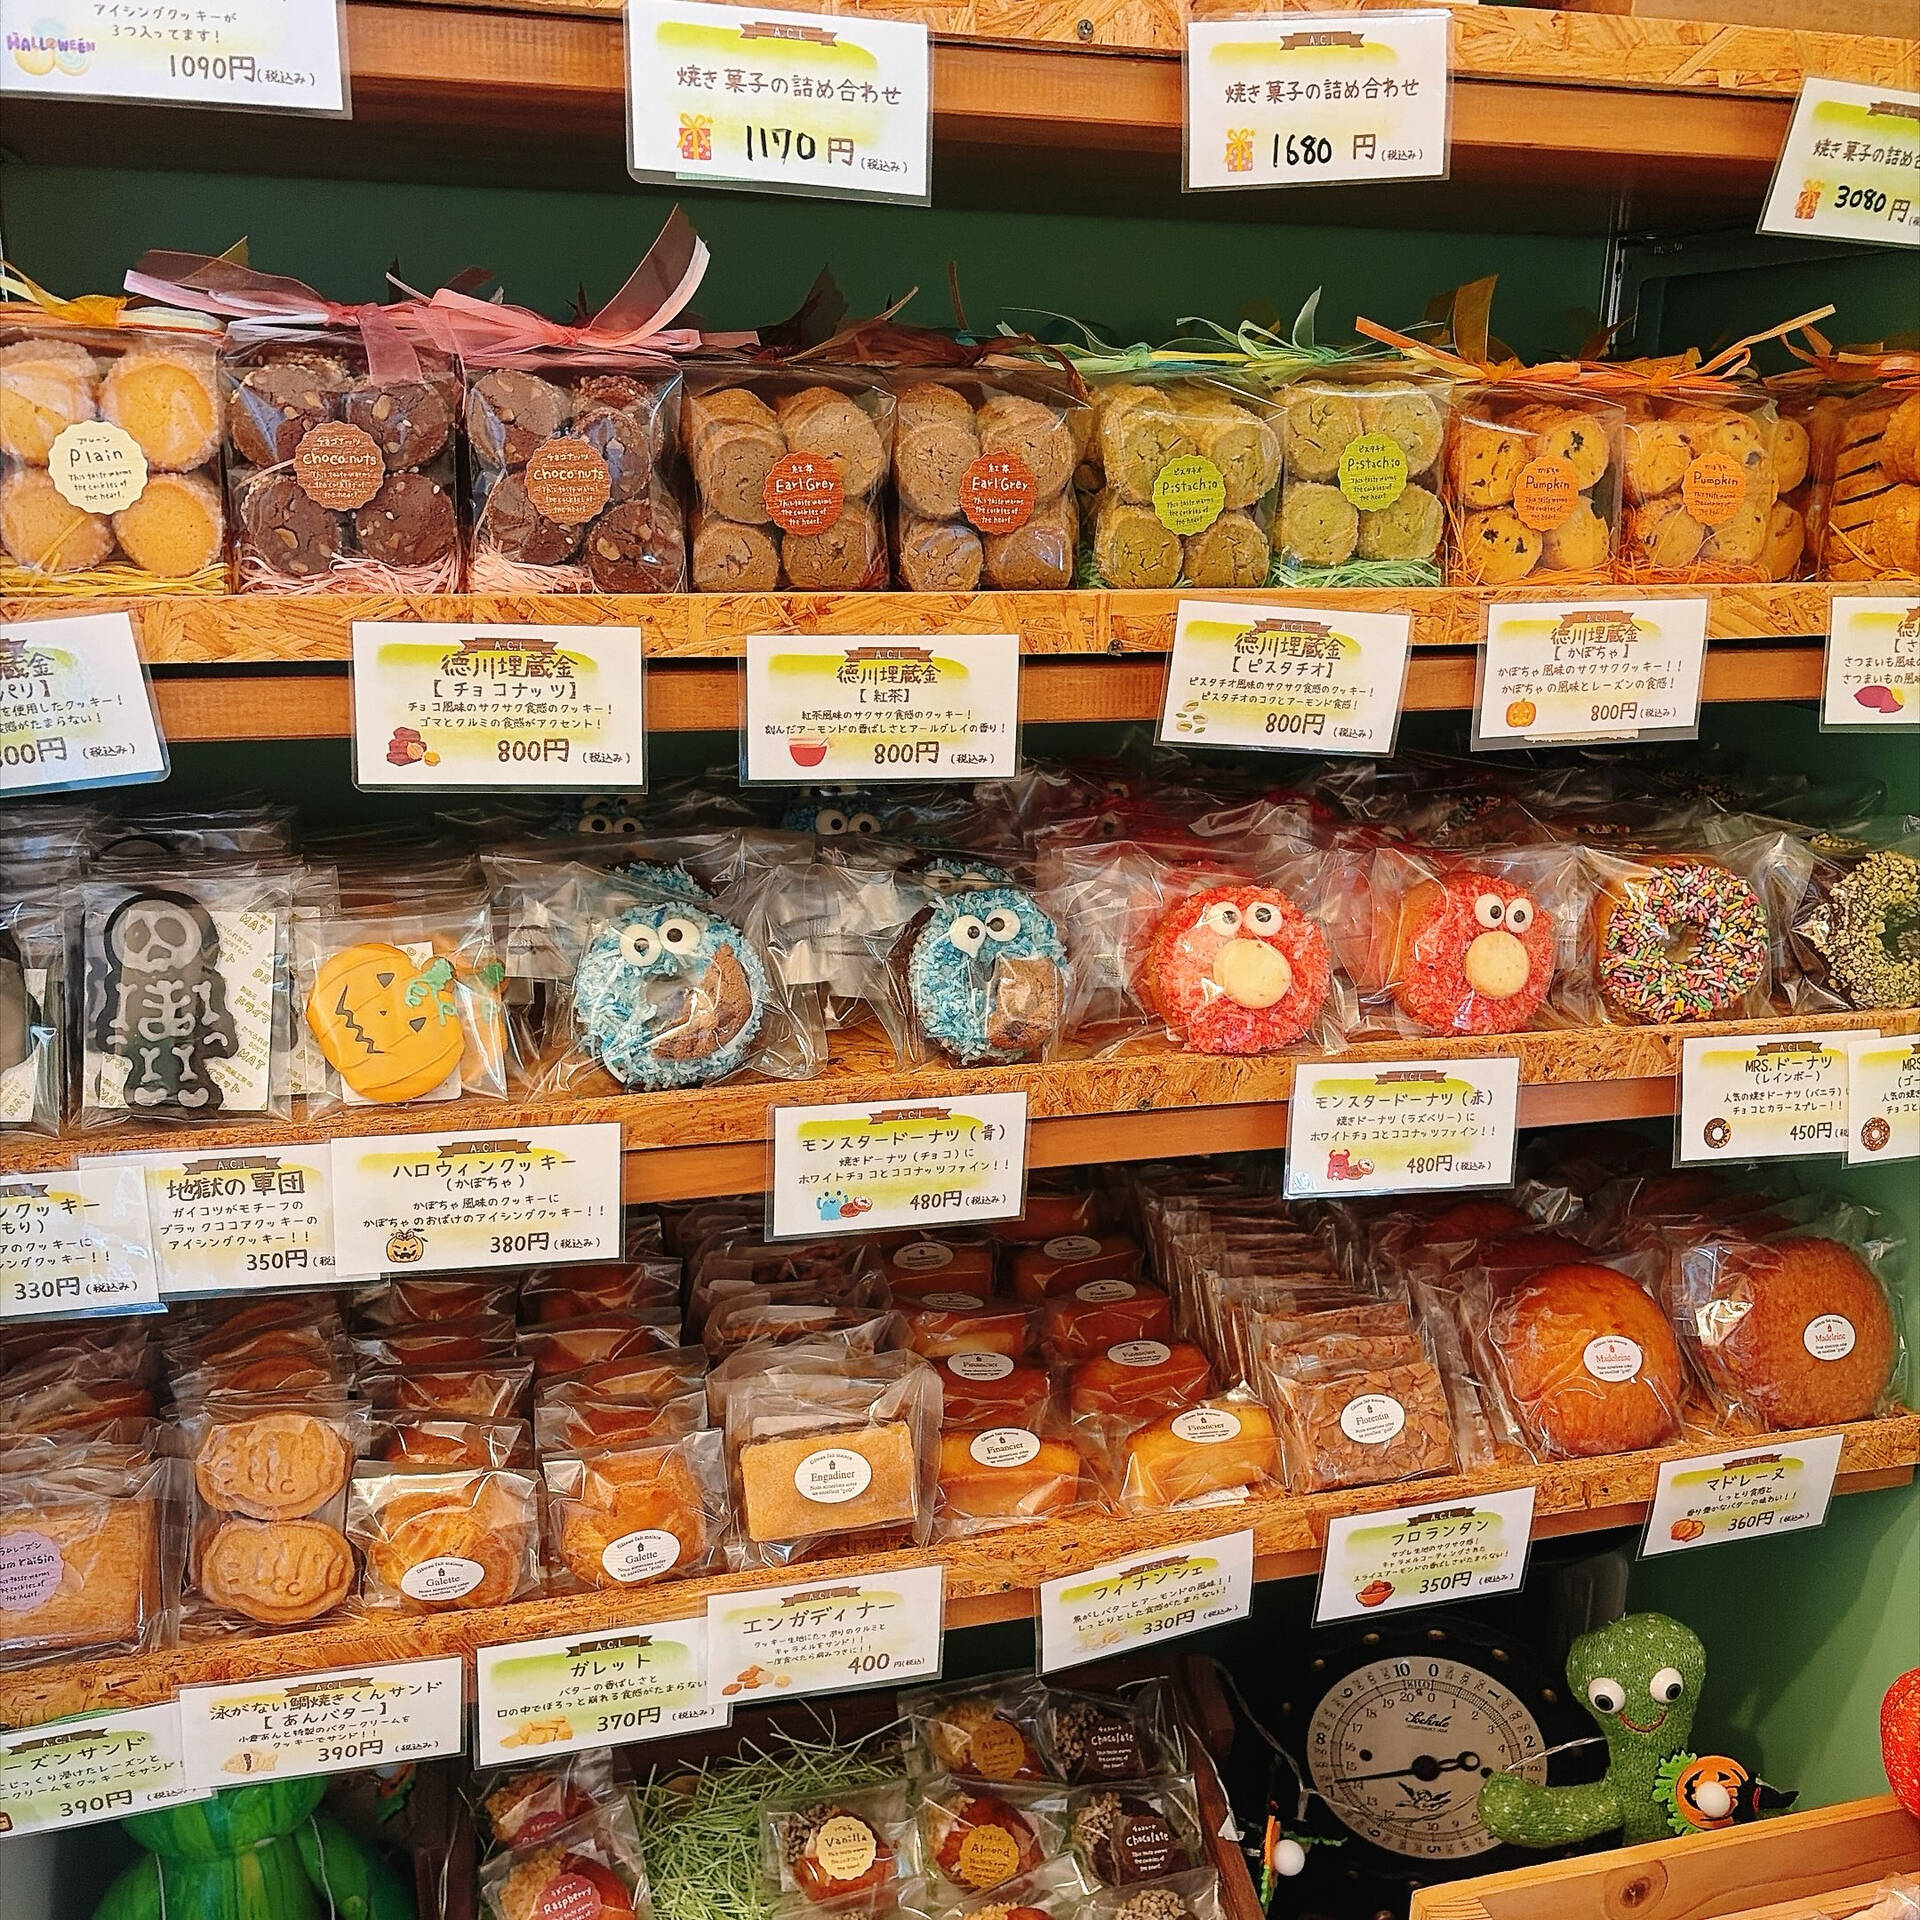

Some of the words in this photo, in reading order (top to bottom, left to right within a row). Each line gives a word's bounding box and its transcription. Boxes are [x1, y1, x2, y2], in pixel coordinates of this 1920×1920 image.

[93, 3, 238, 25] アイシングクッキーが
[676, 64, 902, 106] 焼き菓子の詰め合わせ
[1224, 76, 1420, 104] 焼き菓子の詰め合わせ
[746, 124, 816, 165] 1170
[1273, 133, 1332, 168] 1680
[1834, 185, 1887, 213] 3080
[70, 448, 123, 467] Plain
[1347, 456, 1401, 472] Pistachio
[1162, 479, 1218, 495] Pistachio
[1525, 475, 1570, 491] Pumpkin
[1692, 471, 1738, 487] Pumpkin
[1550, 624, 1642, 645] 徳川埋蔵金
[1234, 632, 1346, 660] 徳川埋蔵金
[440, 652, 578, 680] 徳川埋蔵金
[836, 664, 941, 686] 徳川埋蔵金
[1590, 702, 1638, 722] 800円
[1265, 712, 1326, 736] 800円
[497, 738, 570, 763] 800円
[873, 741, 939, 765] 800円
[1790, 1122, 1832, 1141] 450円
[392, 1154, 577, 1179] ハロウィンクッキー
[1407, 1155, 1452, 1175] 480円
[167, 1170, 305, 1201] 地獄の軍団
[172, 1200, 303, 1218] ガイコツがモチーフの
[414, 1193, 559, 1212] かぼちゃ風味のクッキーに
[910, 1189, 962, 1211] 480円
[160, 1216, 317, 1236] ブラックココアクッキーの
[490, 1232, 550, 1254] 380円
[246, 1249, 308, 1271] 350円
[14, 1276, 80, 1300] 330円
[1355, 1412, 1390, 1426] Florentin
[811, 1470, 856, 1483] Engadiner
[1707, 1467, 1785, 1491] マドレーヌ
[1727, 1511, 1774, 1532] 360円
[1391, 1520, 1489, 1546] フロランタン
[19, 1554, 55, 1567] raisin
[625, 1552, 658, 1564] Galette
[426, 1577, 460, 1586] Galette
[1093, 1565, 1203, 1600] フィナンシェ
[1418, 1570, 1473, 1594] 350円
[742, 1601, 895, 1635] エンガディナー
[1142, 1609, 1195, 1636] 330円
[570, 1653, 651, 1678] ガレット
[847, 1653, 890, 1675] 400
[1394, 1663, 1411, 1677] 10
[1428, 1663, 1439, 1677] 0
[209, 1680, 443, 1722] 泳がない鯛焼きくんサンド
[596, 1706, 661, 1733] 370円
[1091, 1732, 1134, 1746] Chocolate
[317, 1740, 384, 1763] 390円
[59, 1789, 132, 1817] 390円
[824, 1833, 867, 1848] Vanilla
[1125, 1831, 1169, 1847] Chocolate
[544, 1887, 592, 1915] Raspberry
